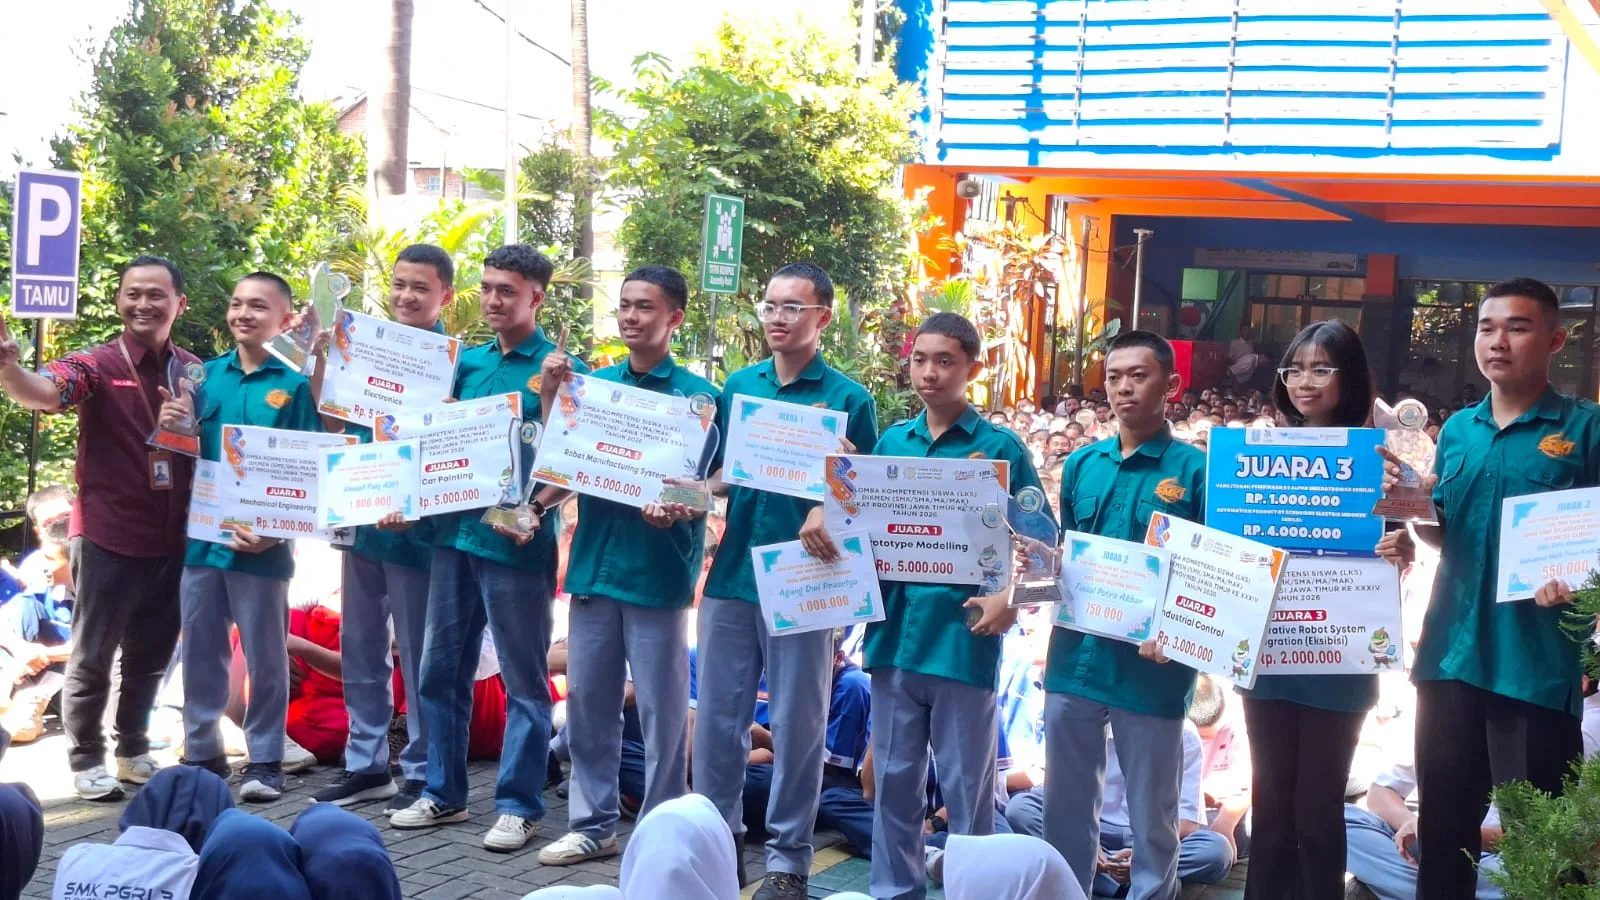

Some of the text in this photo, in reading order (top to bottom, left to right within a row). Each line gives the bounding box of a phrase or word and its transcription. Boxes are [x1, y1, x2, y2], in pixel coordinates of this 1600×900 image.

[26, 182, 72, 266] P
[22, 284, 70, 307] TAMU
[370, 378, 402, 392] JUARA 1
[364, 389, 402, 405] Electronics
[354, 404, 366, 418] Rp.
[602, 444, 632, 458] JUARA
[428, 459, 466, 472] JUARA 1
[564, 448, 667, 480] Robot Manufacturing System
[1236, 456, 1354, 480] JUARA 3
[422, 472, 474, 486] Car Painting
[760, 464, 806, 482] 1.000.000
[576, 472, 642, 497] Rp. 5.000.000
[268, 488, 304, 498] JUARA 3
[435, 488, 480, 506] 5.000.000
[1245, 493, 1340, 507] RP. 1.000.000
[240, 498, 316, 514] Mechanical Engineering
[350, 495, 392, 510] 1.000.000
[256, 516, 313, 532] Rp. 2.000.000
[892, 525, 938, 534] JUARA 1
[1244, 524, 1342, 540] RP. 4.000.000
[870, 540, 968, 552] ototype Modelling
[876, 560, 954, 575] Rp. 5.000.000
[1182, 556, 1251, 584] KOMPETENSI SISWA (LKS)
[1544, 560, 1588, 580] 550.000
[780, 588, 804, 598] Agung
[806, 584, 820, 594] Dwi
[1184, 582, 1202, 592] TAHUN
[1197, 578, 1212, 588] JAWA
[1214, 584, 1230, 593] TIMUR
[799, 596, 849, 612] 1.000.000
[1087, 602, 1123, 622] 750.000
[1178, 596, 1214, 617] JUARA 2
[1162, 609, 1224, 638] ndustrial Control
[1272, 611, 1324, 620] JUARA 3
[1299, 625, 1366, 635] Robot System
[1157, 630, 1213, 662] Rp. 3.000.000
[1305, 636, 1348, 648] (Eksibisi)
[1280, 650, 1342, 664] 2.000.000
[64, 882, 102, 897] SMK
[104, 884, 152, 900] PGRI
